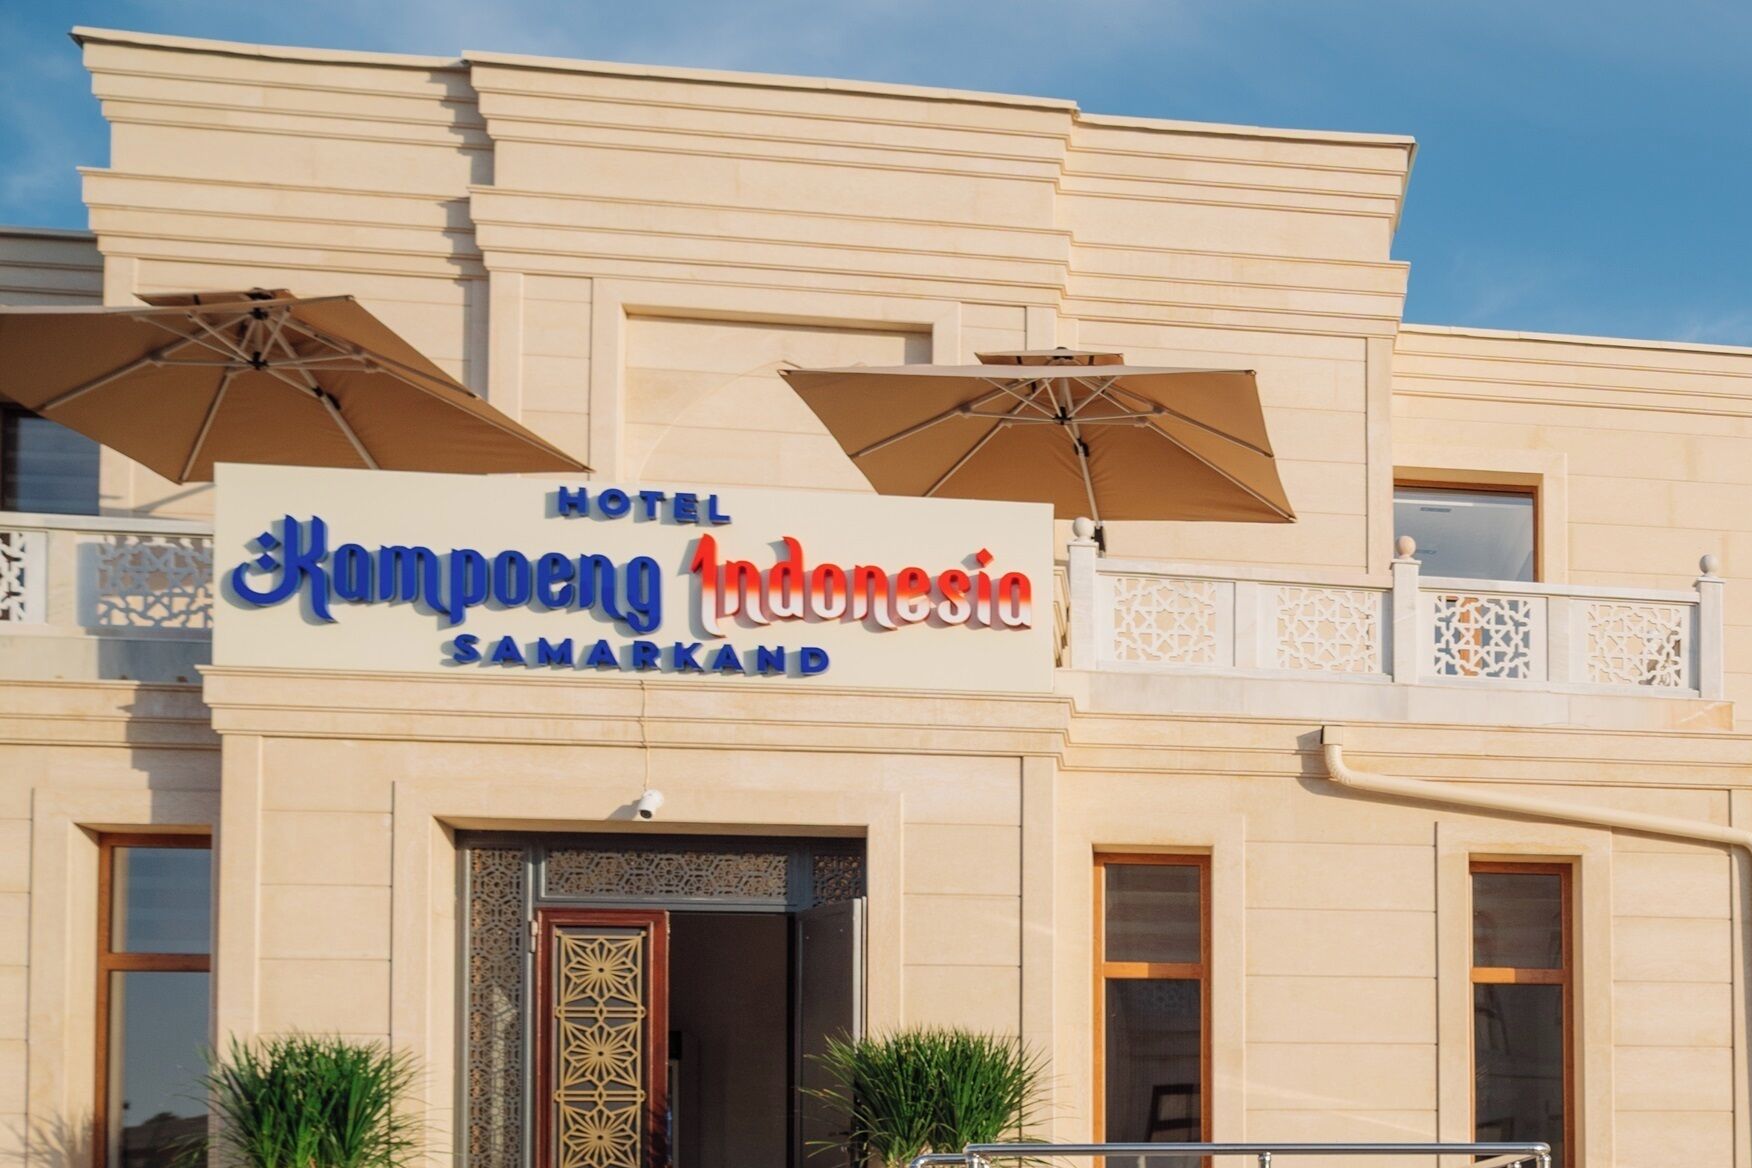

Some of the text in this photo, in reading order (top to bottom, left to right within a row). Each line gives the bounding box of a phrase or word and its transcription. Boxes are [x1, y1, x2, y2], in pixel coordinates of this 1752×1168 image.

[558, 486, 731, 524] HOTEL
[231, 515, 1033, 637] Kampoeng Indonesia
[452, 634, 829, 676] SAMARKAND
